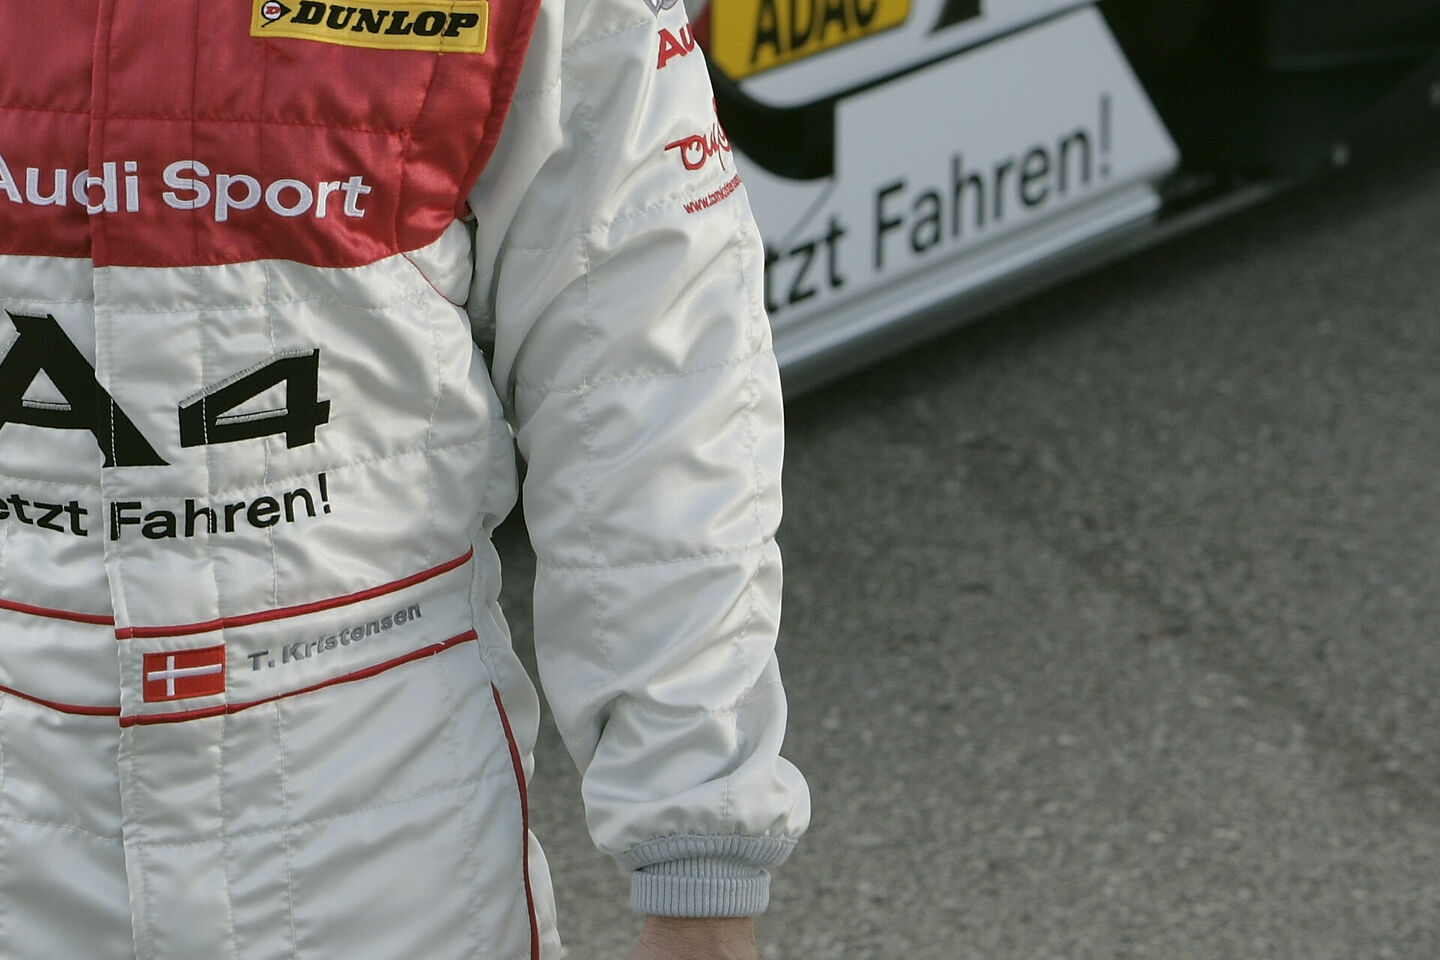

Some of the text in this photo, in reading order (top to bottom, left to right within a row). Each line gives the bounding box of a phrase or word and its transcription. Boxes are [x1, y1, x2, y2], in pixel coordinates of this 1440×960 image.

[290, 0, 480, 38] DUNLOP
[161, 159, 372, 223] Sport
[873, 93, 1112, 270] Fahren!
[109, 472, 333, 541] Fahren!
[247, 603, 423, 672] T. Kristensen
